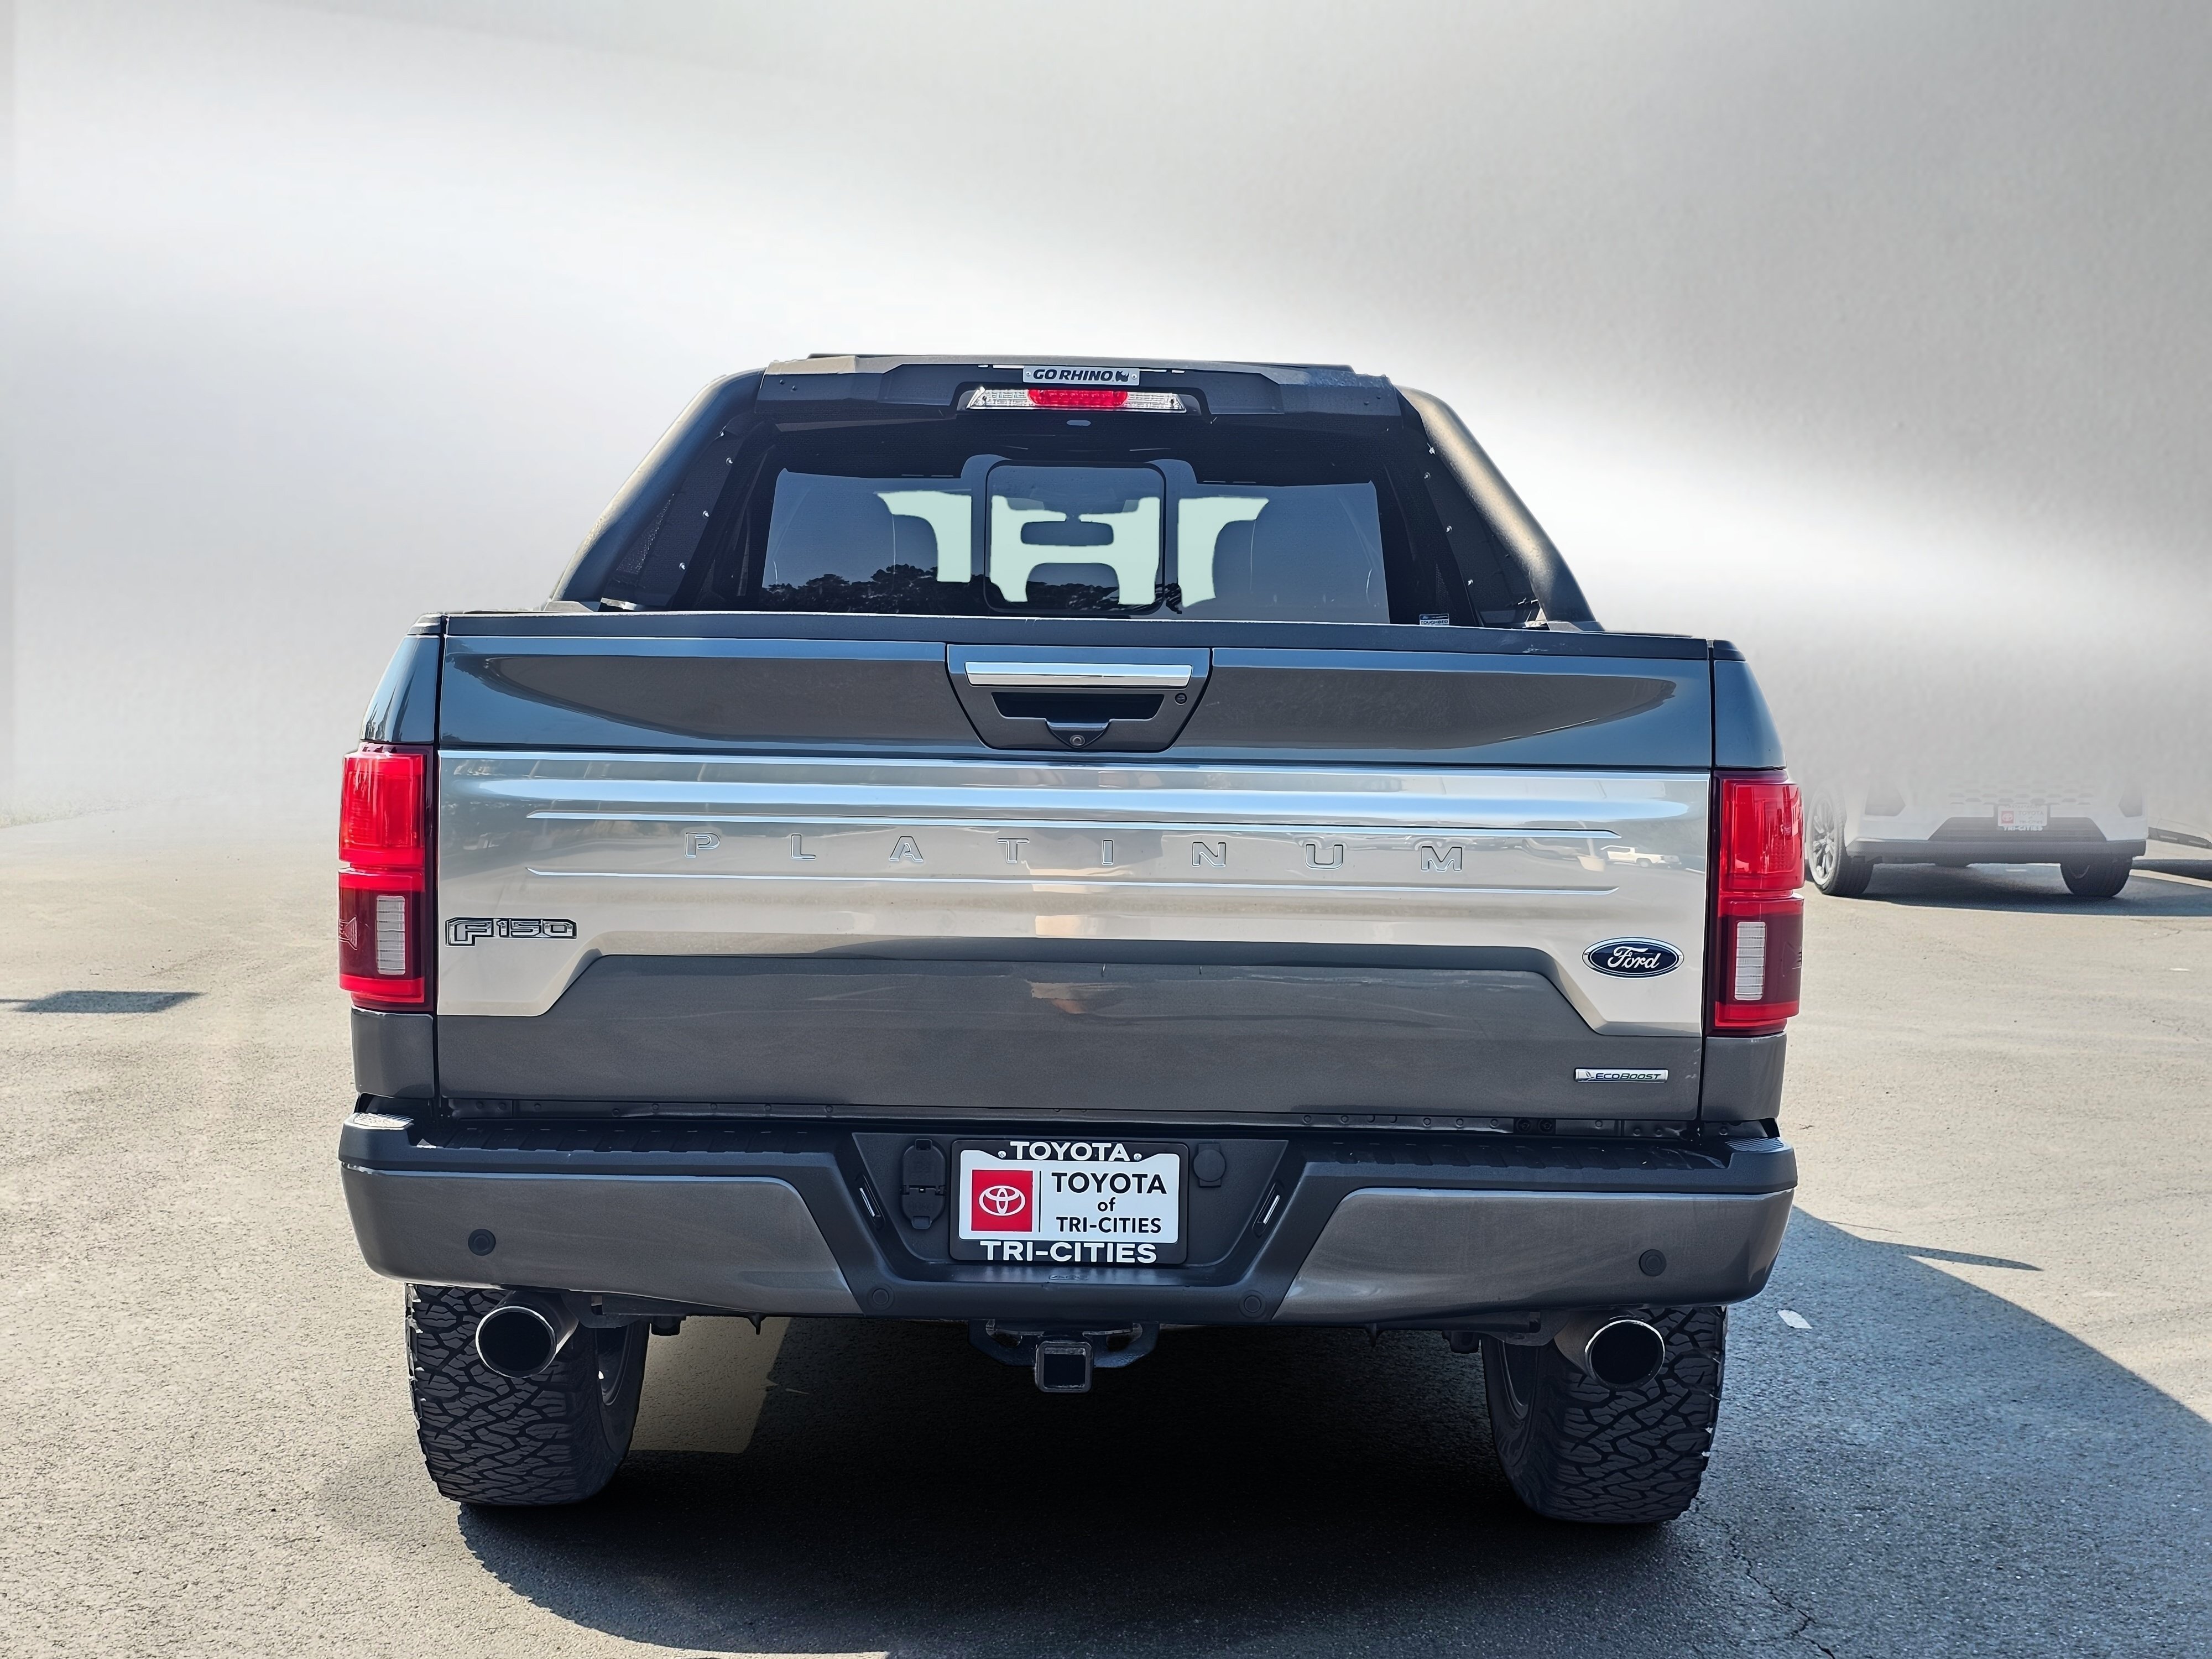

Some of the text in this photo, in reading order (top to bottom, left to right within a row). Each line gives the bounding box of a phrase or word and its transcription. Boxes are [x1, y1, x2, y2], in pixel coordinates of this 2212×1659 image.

[1033, 368, 1113, 382] GO RHINO
[685, 832, 1463, 872] PLATINUM
[1607, 946, 1661, 969] Ford
[1010, 1141, 1130, 1162] TOYOTA
[1051, 1172, 1167, 1194] TOYOTA
[1097, 1197, 1116, 1212] of
[1056, 1216, 1161, 1233] TRI-CITIES
[979, 1240, 1157, 1264] TRI-CITIES
